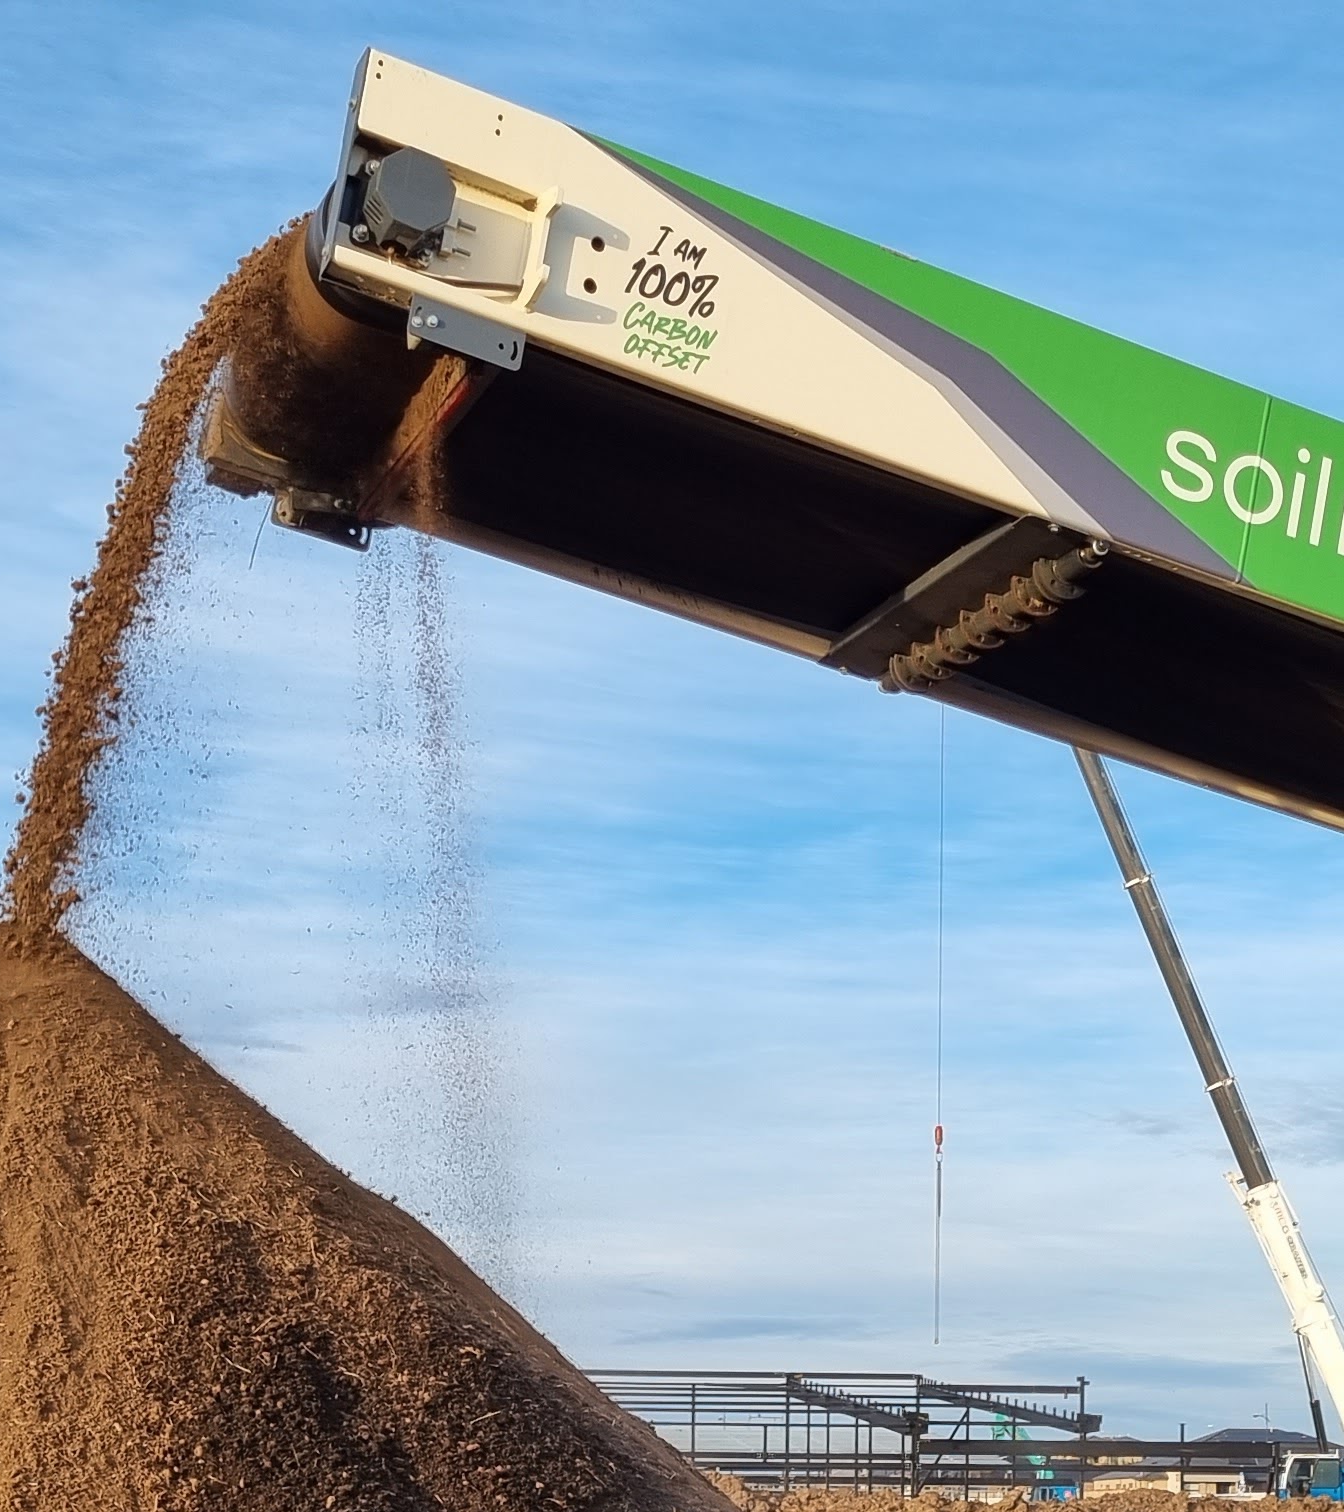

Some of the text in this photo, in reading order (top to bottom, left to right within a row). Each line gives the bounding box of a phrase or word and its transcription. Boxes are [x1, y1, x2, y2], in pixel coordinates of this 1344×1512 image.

[647, 226, 707, 270] I AM
[624, 258, 719, 318] 100%
[623, 302, 718, 349] CARBON
[623, 334, 710, 374] OFFSET
